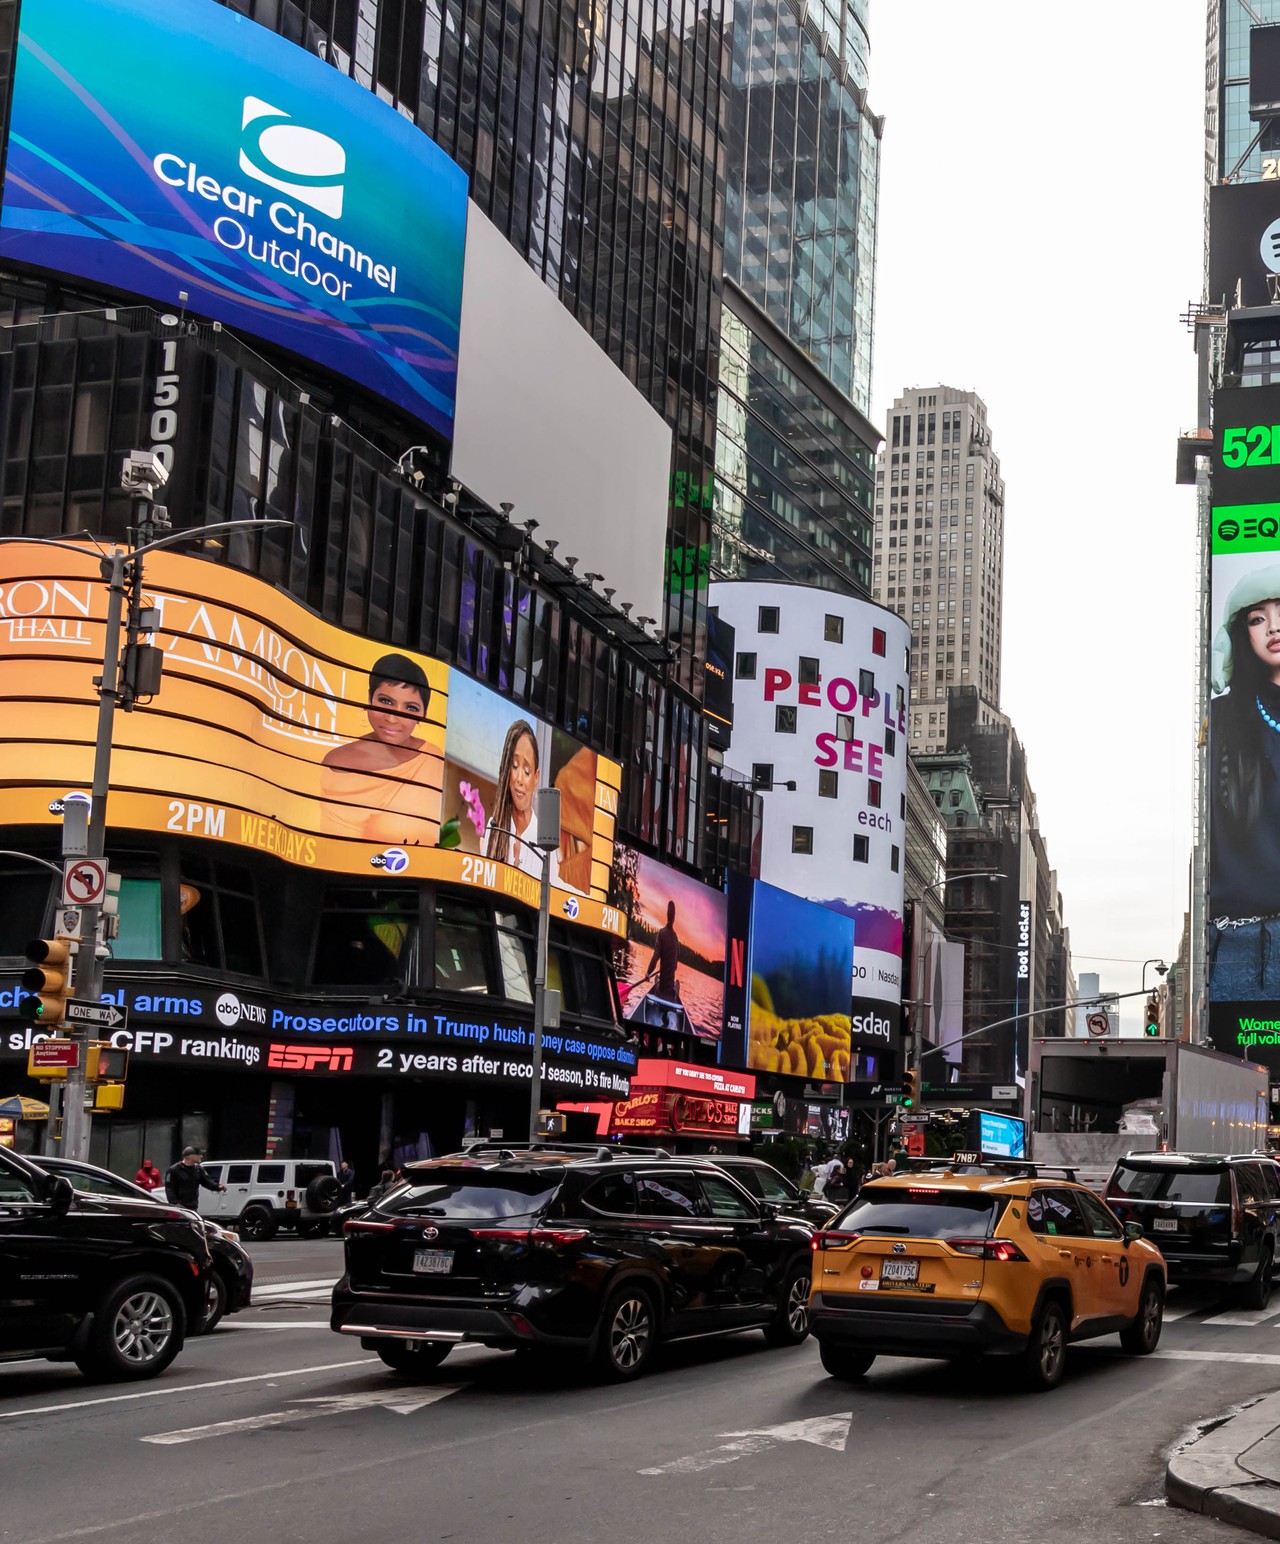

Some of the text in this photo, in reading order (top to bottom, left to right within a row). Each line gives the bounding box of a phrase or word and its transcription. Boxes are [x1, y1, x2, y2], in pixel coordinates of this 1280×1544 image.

[153, 152, 397, 293] Clear Channel
[213, 216, 352, 301] Outdoor
[14, 619, 82, 640] HALL
[142, 593, 346, 716] TAMRON
[268, 698, 352, 742] HALL
[814, 732, 883, 778] SEE
[167, 800, 226, 837] 2PM
[858, 809, 892, 833] each
[240, 814, 317, 864] WEEKDAYS
[370, 857, 386, 866] abc
[461, 856, 496, 887] 2PM
[601, 907, 619, 932] 2PM
[1018, 904, 1030, 978] Foot Locker
[73, 1007, 118, 1021] ONE WAY
[134, 994, 203, 1015] arms
[217, 1002, 266, 1024] abc NEWS
[727, 1020, 742, 1030] PLAYING
[730, 1015, 739, 1023] NOW
[272, 1009, 615, 1060] Prosecutors in Trump hush case oppose
[1237, 1032, 1257, 1045] full
[110, 1031, 260, 1066] CFP rankings
[268, 1043, 354, 1071] ESPN
[377, 1049, 611, 1089] 2 years after season, B's fire
[615, 1094, 658, 1117] CARLO'S
[615, 1118, 656, 1126] BAKE SHOP
[956, 1153, 977, 1163] 7N87
